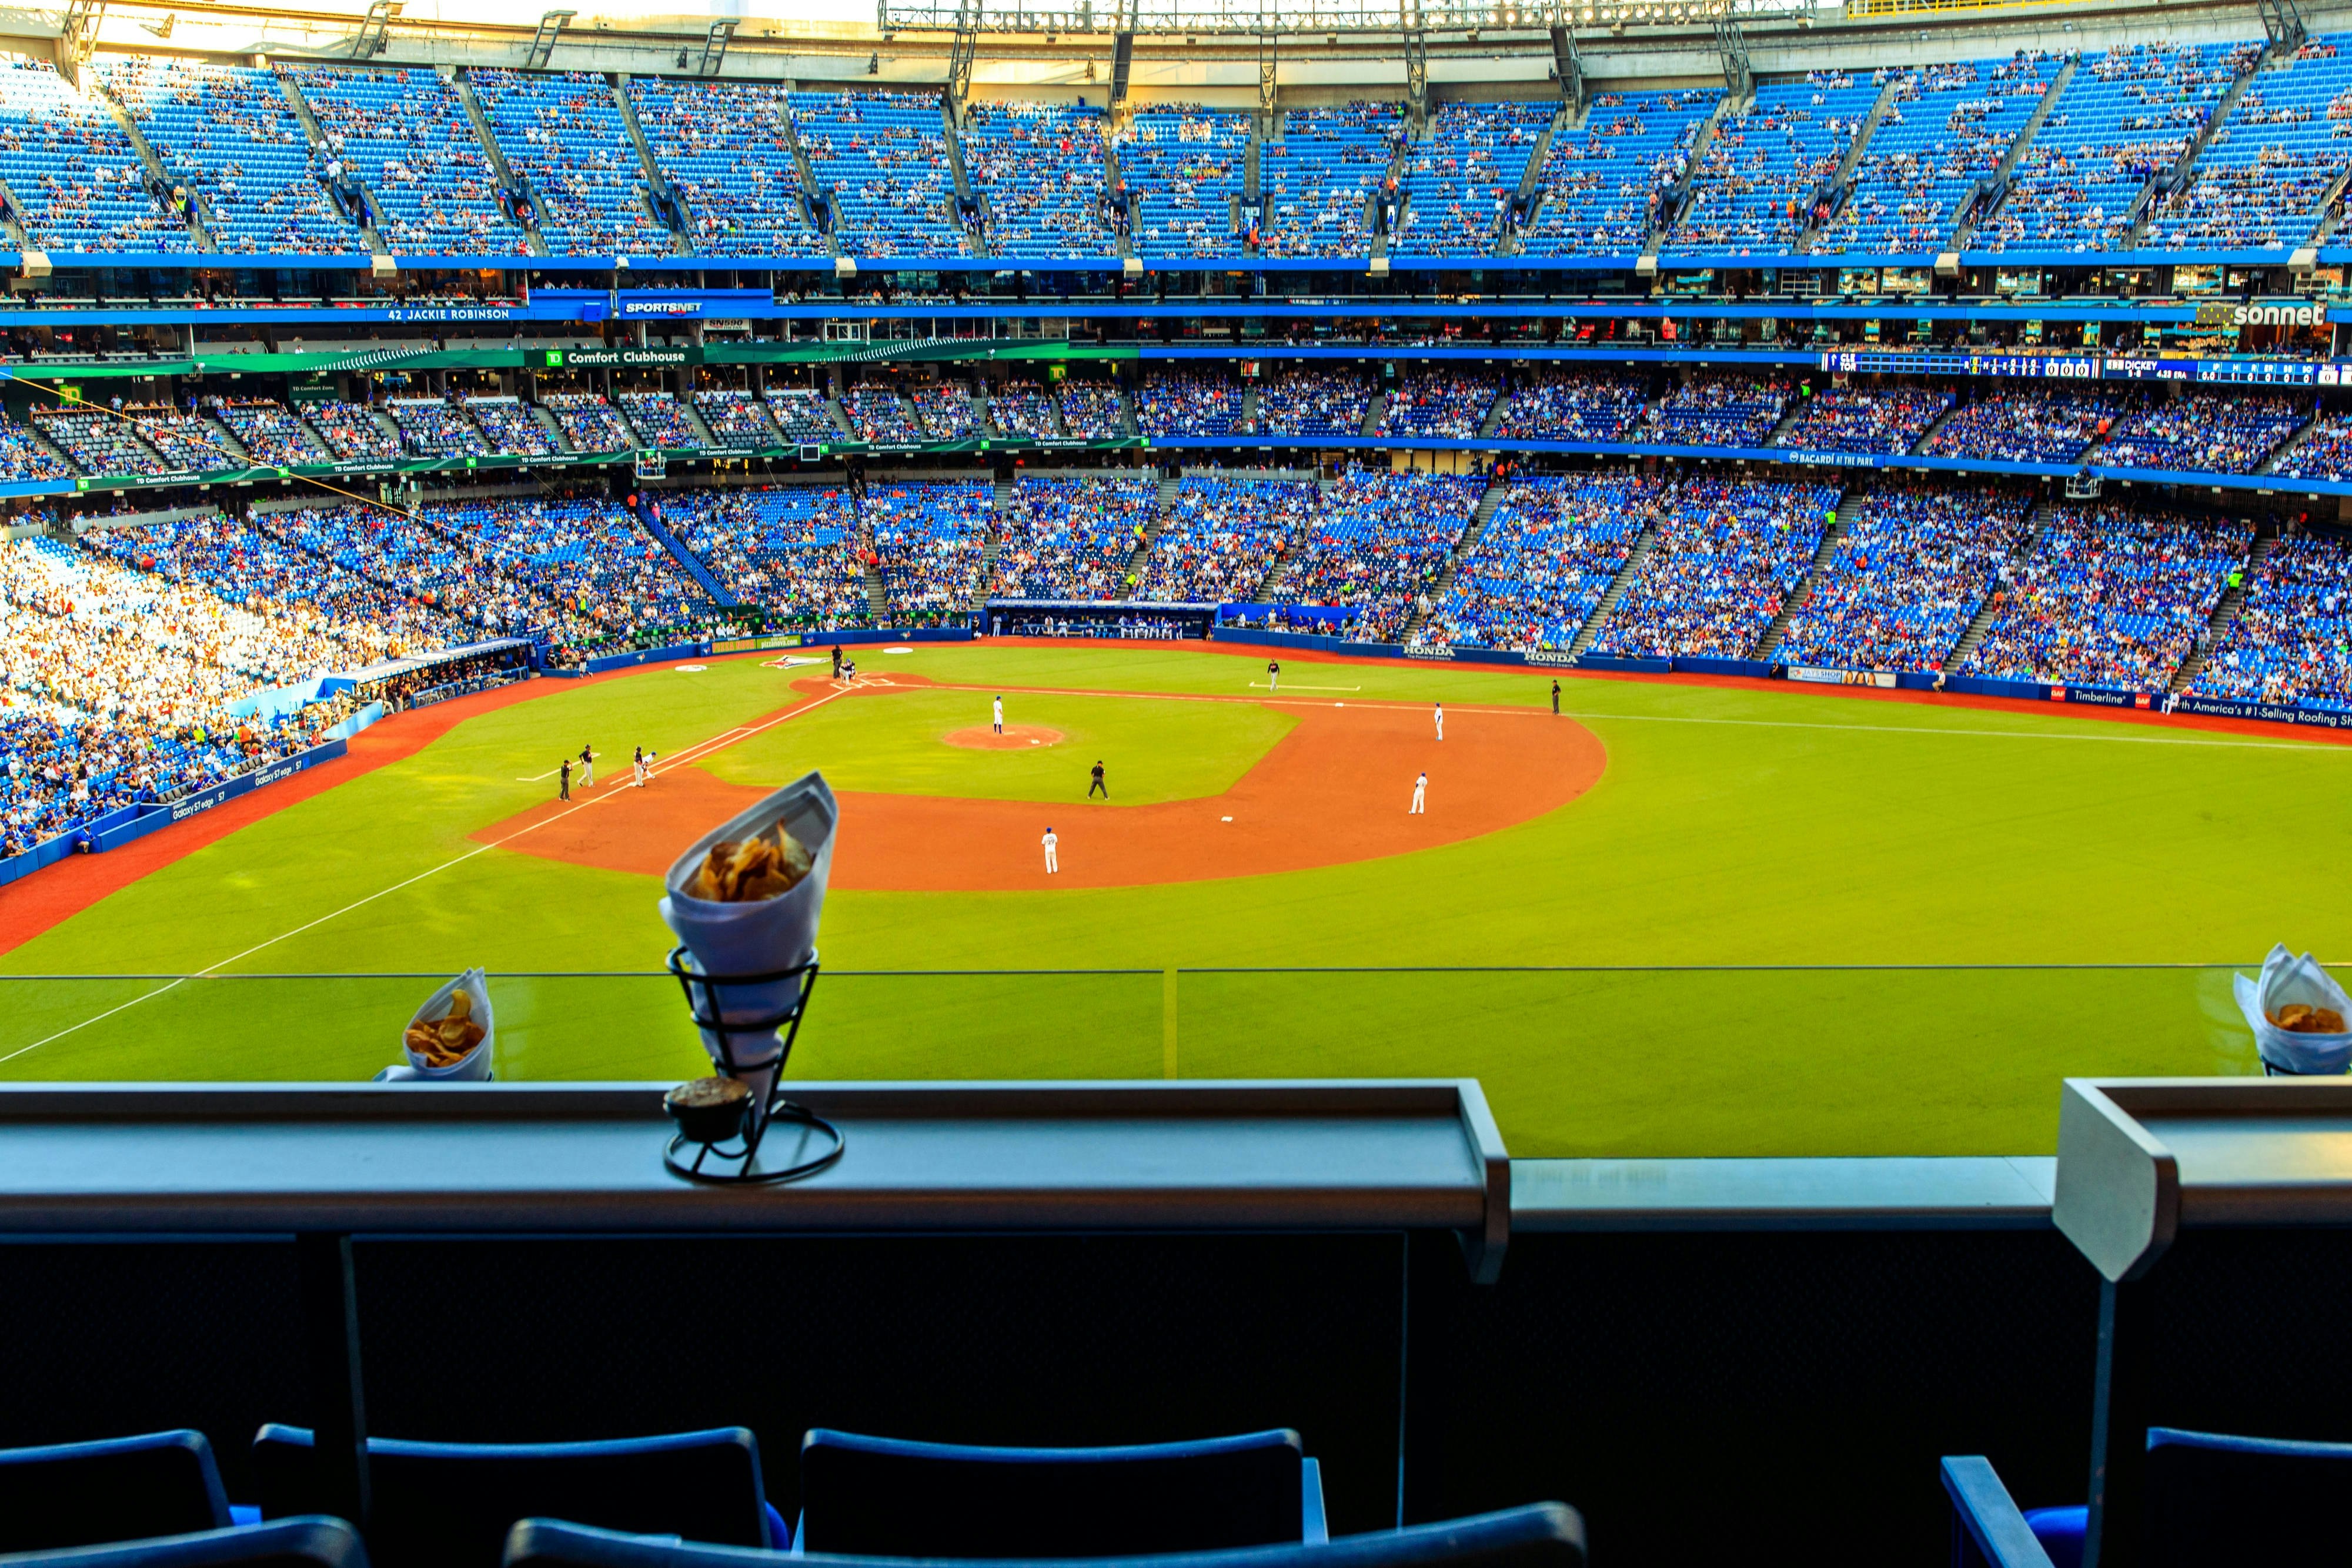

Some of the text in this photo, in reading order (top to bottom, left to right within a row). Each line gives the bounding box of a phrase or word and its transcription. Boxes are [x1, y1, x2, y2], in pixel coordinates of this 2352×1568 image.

[626, 302, 702, 313] SPORTSNET
[388, 309, 509, 320] 42 JACKIE ROBINSON
[2234, 305, 2324, 326] sonnet
[547, 351, 685, 363] TD Comfort Clubhouse
[1840, 353, 1855, 362] CLE
[1840, 362, 1856, 372] TOR
[1964, 361, 1969, 369] R
[2125, 360, 2157, 370] DICKEY
[1051, 367, 1065, 379] TD
[2048, 366, 2085, 376] 0 0 0
[2202, 371, 2215, 380] 0.0
[61, 388, 80, 402] TD
[1800, 453, 1873, 467] BACARDÍ AT THE PARK
[712, 639, 754, 653] PIZZA NOVA
[761, 638, 798, 650] pizzanova.com
[1404, 647, 1455, 656] HONDA
[1524, 653, 1578, 663] HONDA
[2193, 700, 2241, 716] America's
[2245, 705, 2295, 723] #1-Selling
[2298, 711, 2337, 727] Roofing
[255, 760, 302, 787] Galaxy S7 edge S7
[173, 791, 225, 820] Galaxy S7 edge S7
